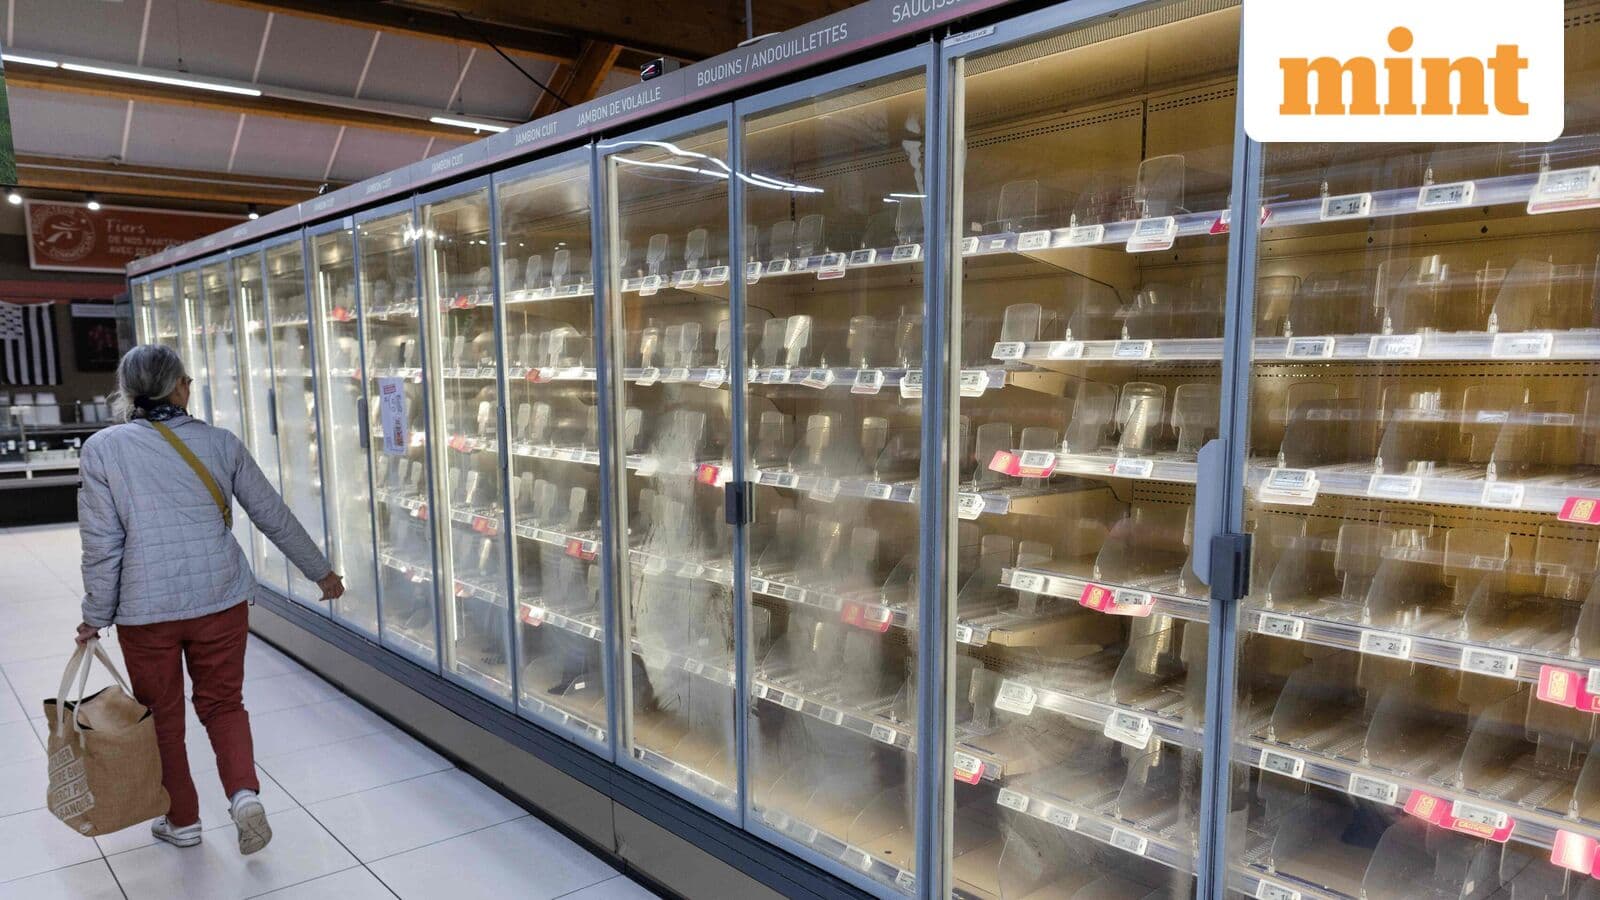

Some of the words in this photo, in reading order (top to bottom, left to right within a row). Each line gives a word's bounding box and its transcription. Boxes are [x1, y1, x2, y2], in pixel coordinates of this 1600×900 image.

[892, 0, 961, 22] SAUCI
[697, 58, 742, 87] BOUDINS
[751, 22, 849, 69] ANDOUILLETTES
[576, 107, 608, 128] JAMBON
[610, 102, 621, 116] DE
[621, 87, 662, 113] VOLAILLE
[514, 128, 541, 147] JAMBON
[541, 121, 558, 138] CUIT
